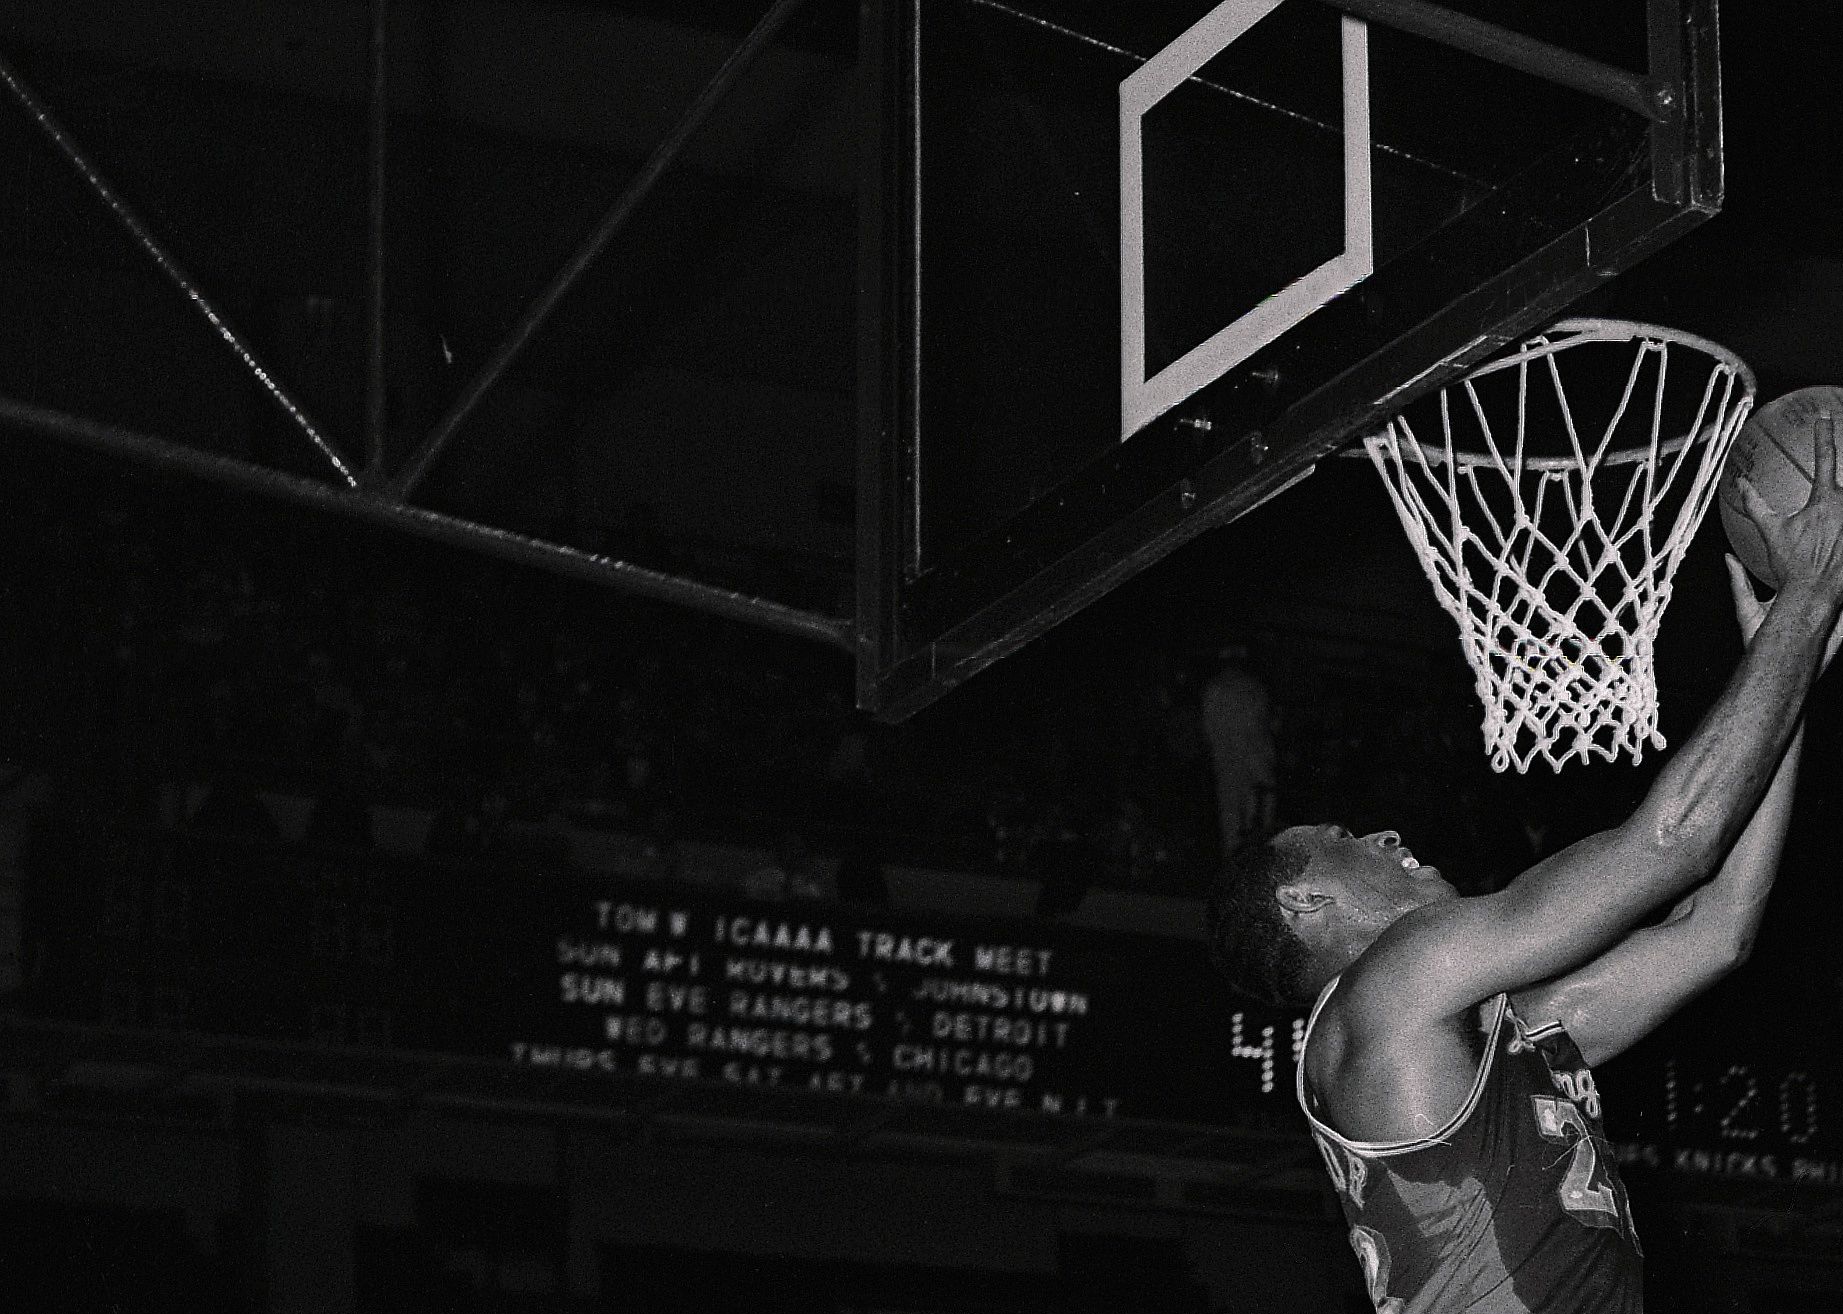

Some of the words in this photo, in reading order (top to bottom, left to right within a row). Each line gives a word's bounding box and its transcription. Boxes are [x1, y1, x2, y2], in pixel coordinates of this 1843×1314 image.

[856, 929, 956, 969] TRACK
[973, 944, 1053, 977] MEET
[727, 989, 874, 1032] RANGERS
[931, 1010, 1069, 1048] DETROIT
[686, 1021, 834, 1063] RANGERS
[892, 1043, 1034, 1083] CHICAGO
[1664, 1060, 1818, 1145] 1:20
[1675, 1148, 1777, 1180] KNICKS
